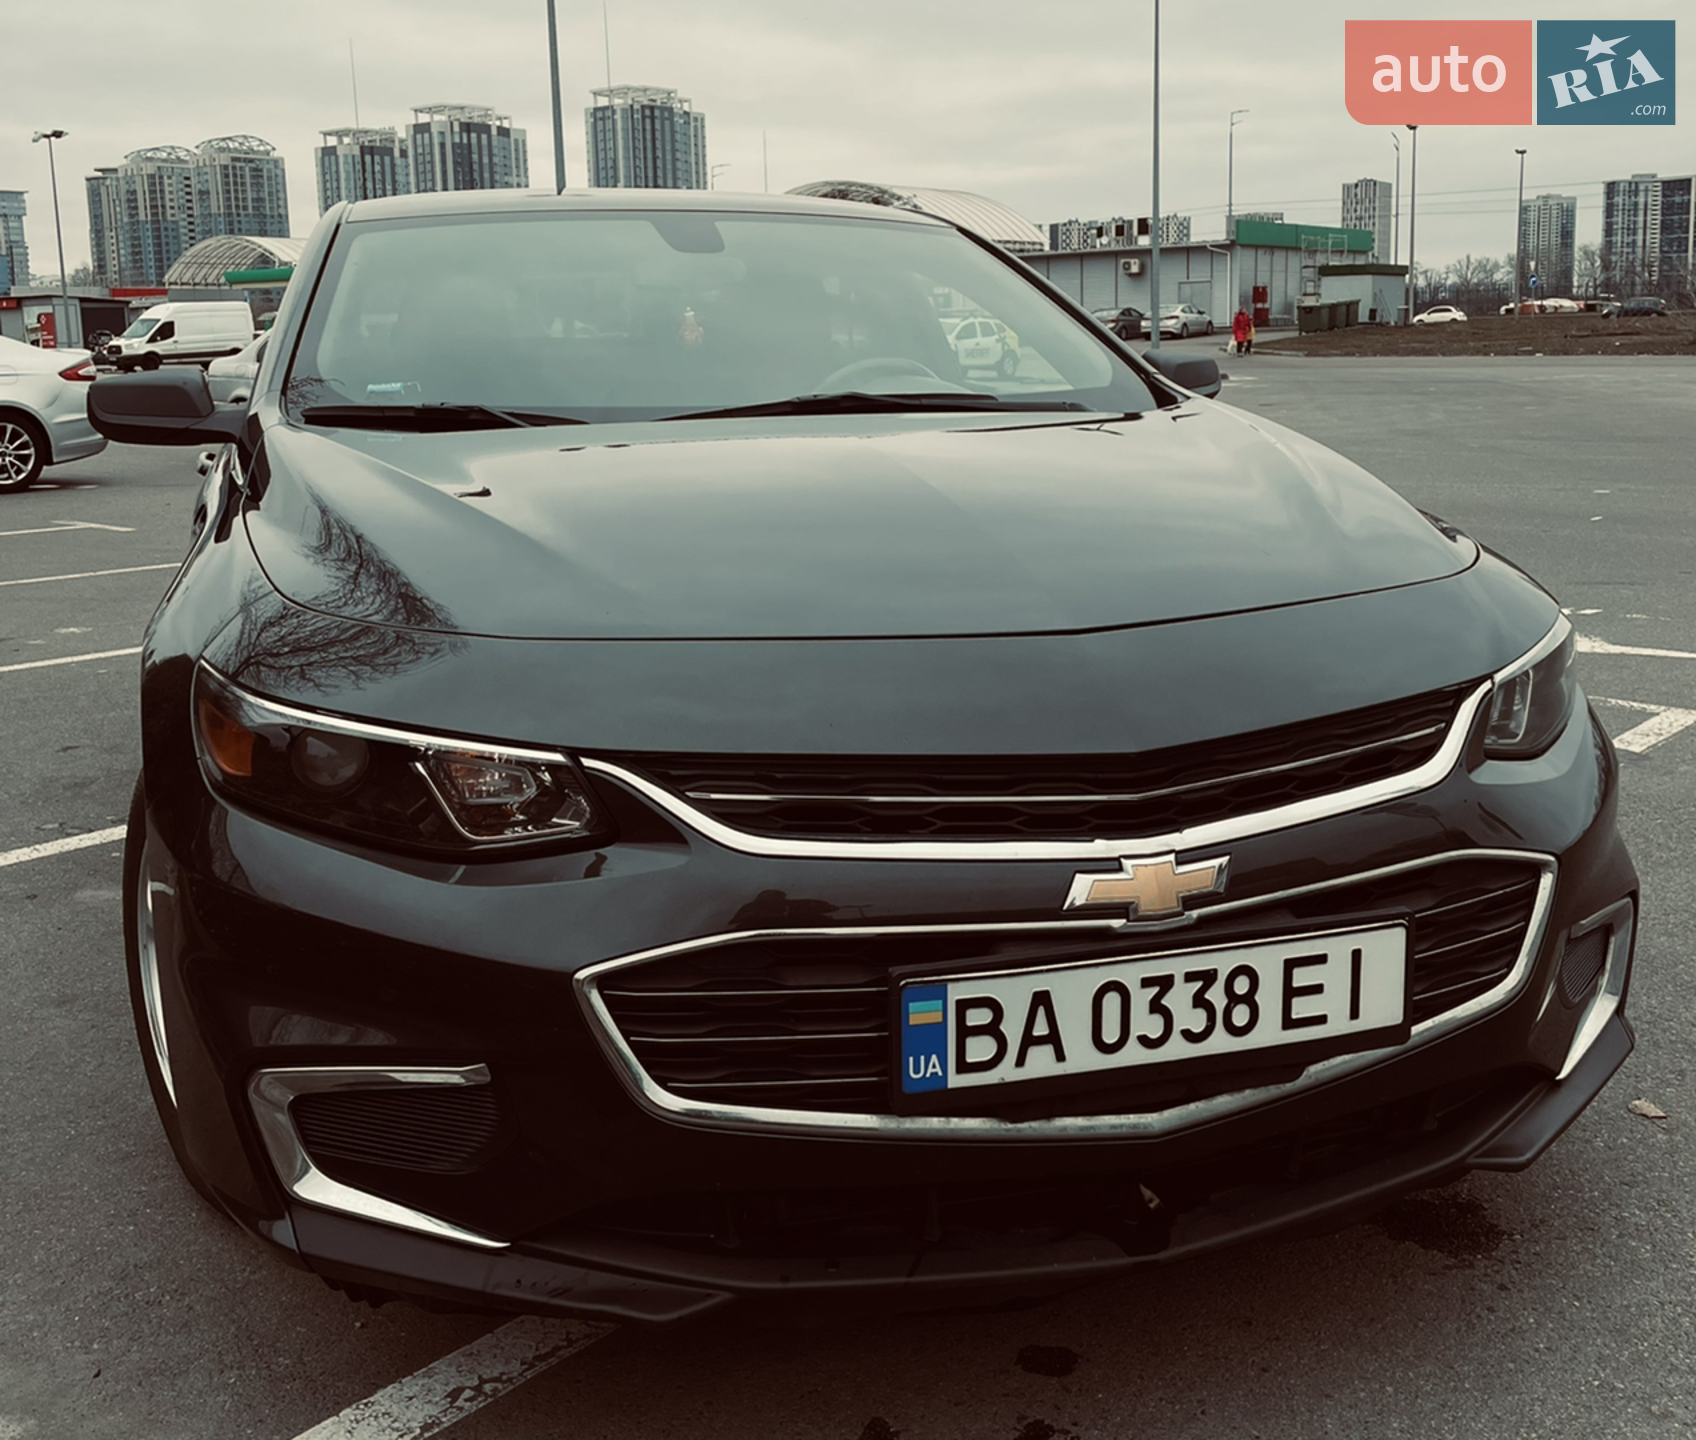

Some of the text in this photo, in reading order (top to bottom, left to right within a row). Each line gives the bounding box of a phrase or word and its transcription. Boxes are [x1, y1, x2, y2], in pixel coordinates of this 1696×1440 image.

[954, 947, 1363, 1075] BA 0338 EI
[908, 1054, 943, 1079] UA
